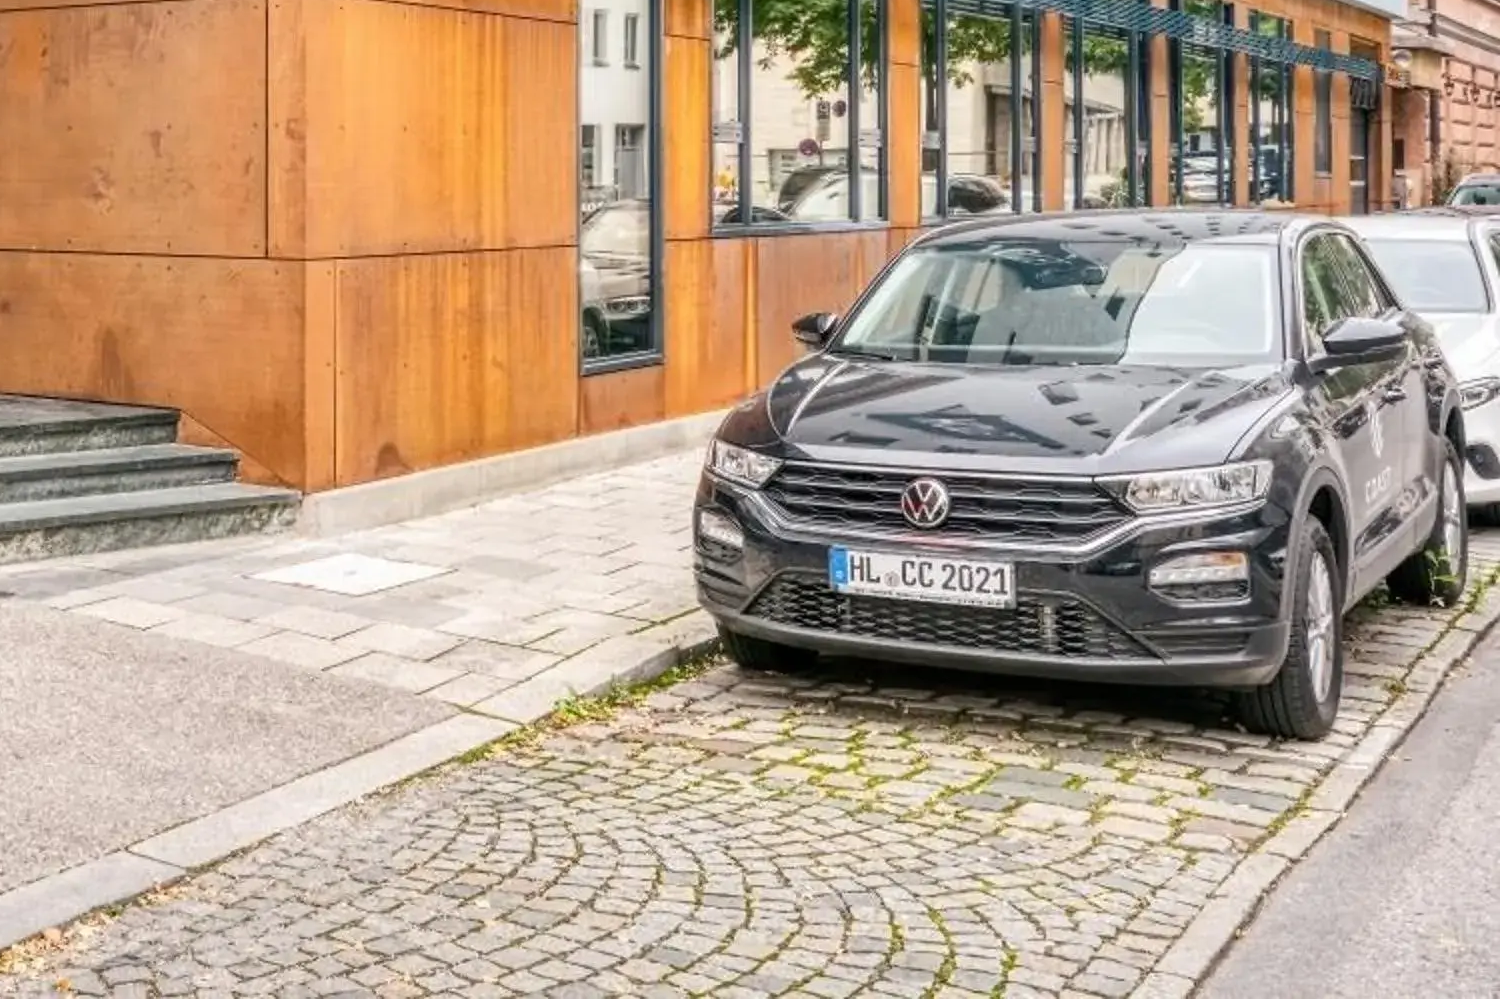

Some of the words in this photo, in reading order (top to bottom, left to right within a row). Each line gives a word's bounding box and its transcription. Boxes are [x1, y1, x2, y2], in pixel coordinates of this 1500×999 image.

[850, 555, 880, 583] HL
[901, 560, 934, 588] CC
[941, 564, 1008, 596] 2021
